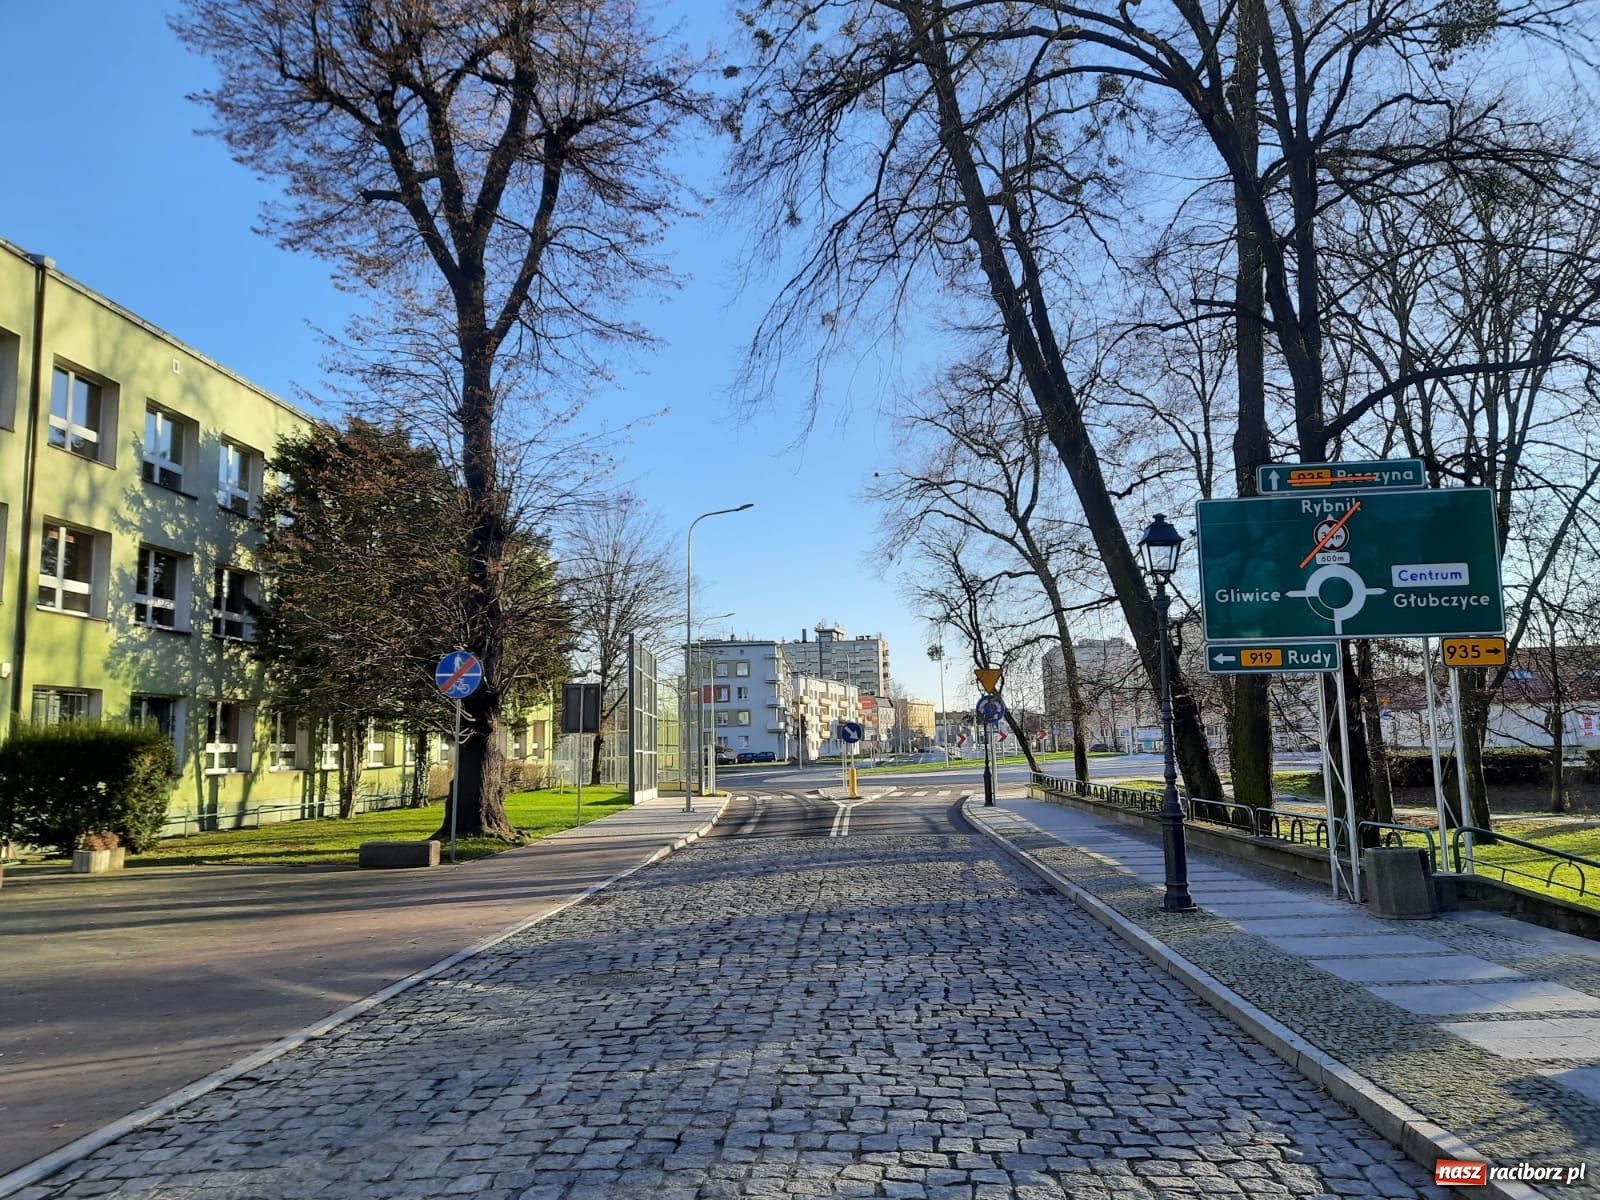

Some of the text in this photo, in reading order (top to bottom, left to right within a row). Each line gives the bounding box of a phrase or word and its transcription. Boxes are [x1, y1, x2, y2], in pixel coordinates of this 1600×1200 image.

[1398, 569, 1462, 582] Centrum
[1215, 588, 1281, 603] Gliwice
[1393, 593, 1490, 611] Głubczyce
[1250, 649, 1331, 668] 919 Rudy
[1446, 645, 1481, 660] 935
